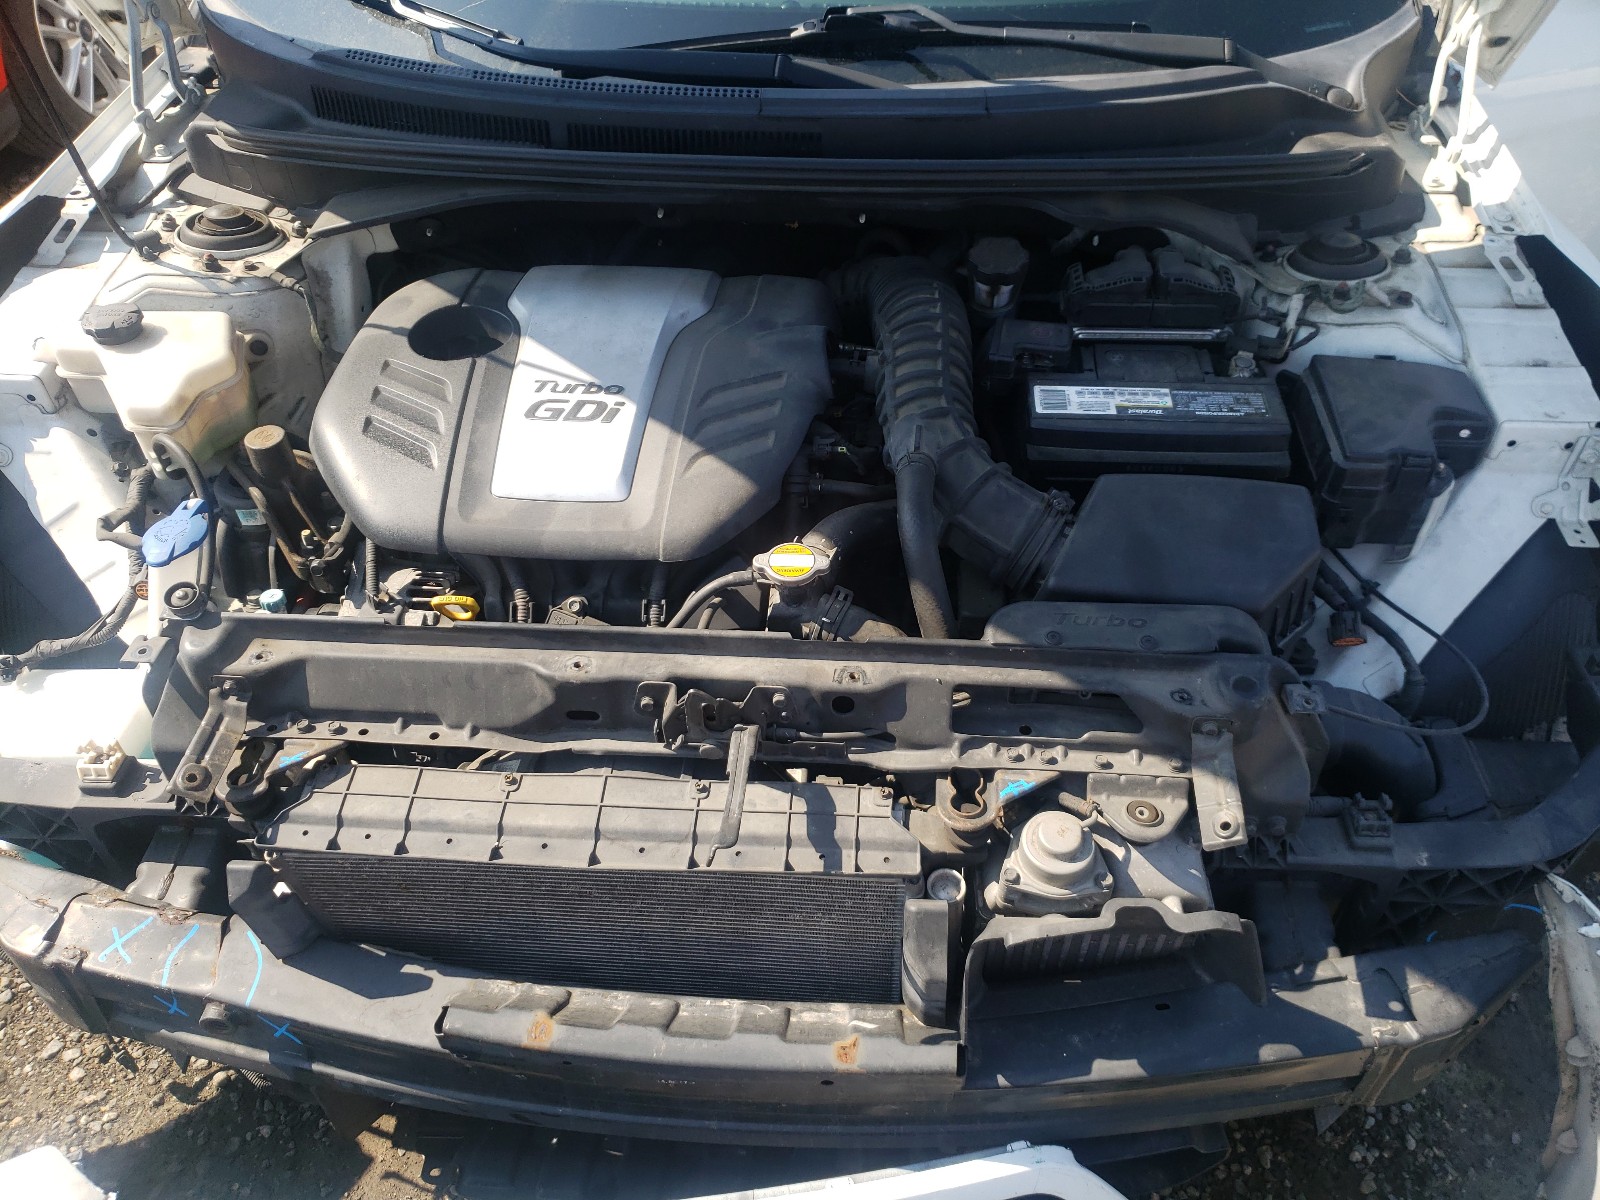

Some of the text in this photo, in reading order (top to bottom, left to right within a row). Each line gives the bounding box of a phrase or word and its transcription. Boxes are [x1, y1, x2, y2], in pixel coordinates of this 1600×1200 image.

[534, 380, 625, 395] Turbo
[524, 399, 627, 423] GDi
[1054, 612, 1148, 628] Turbo
